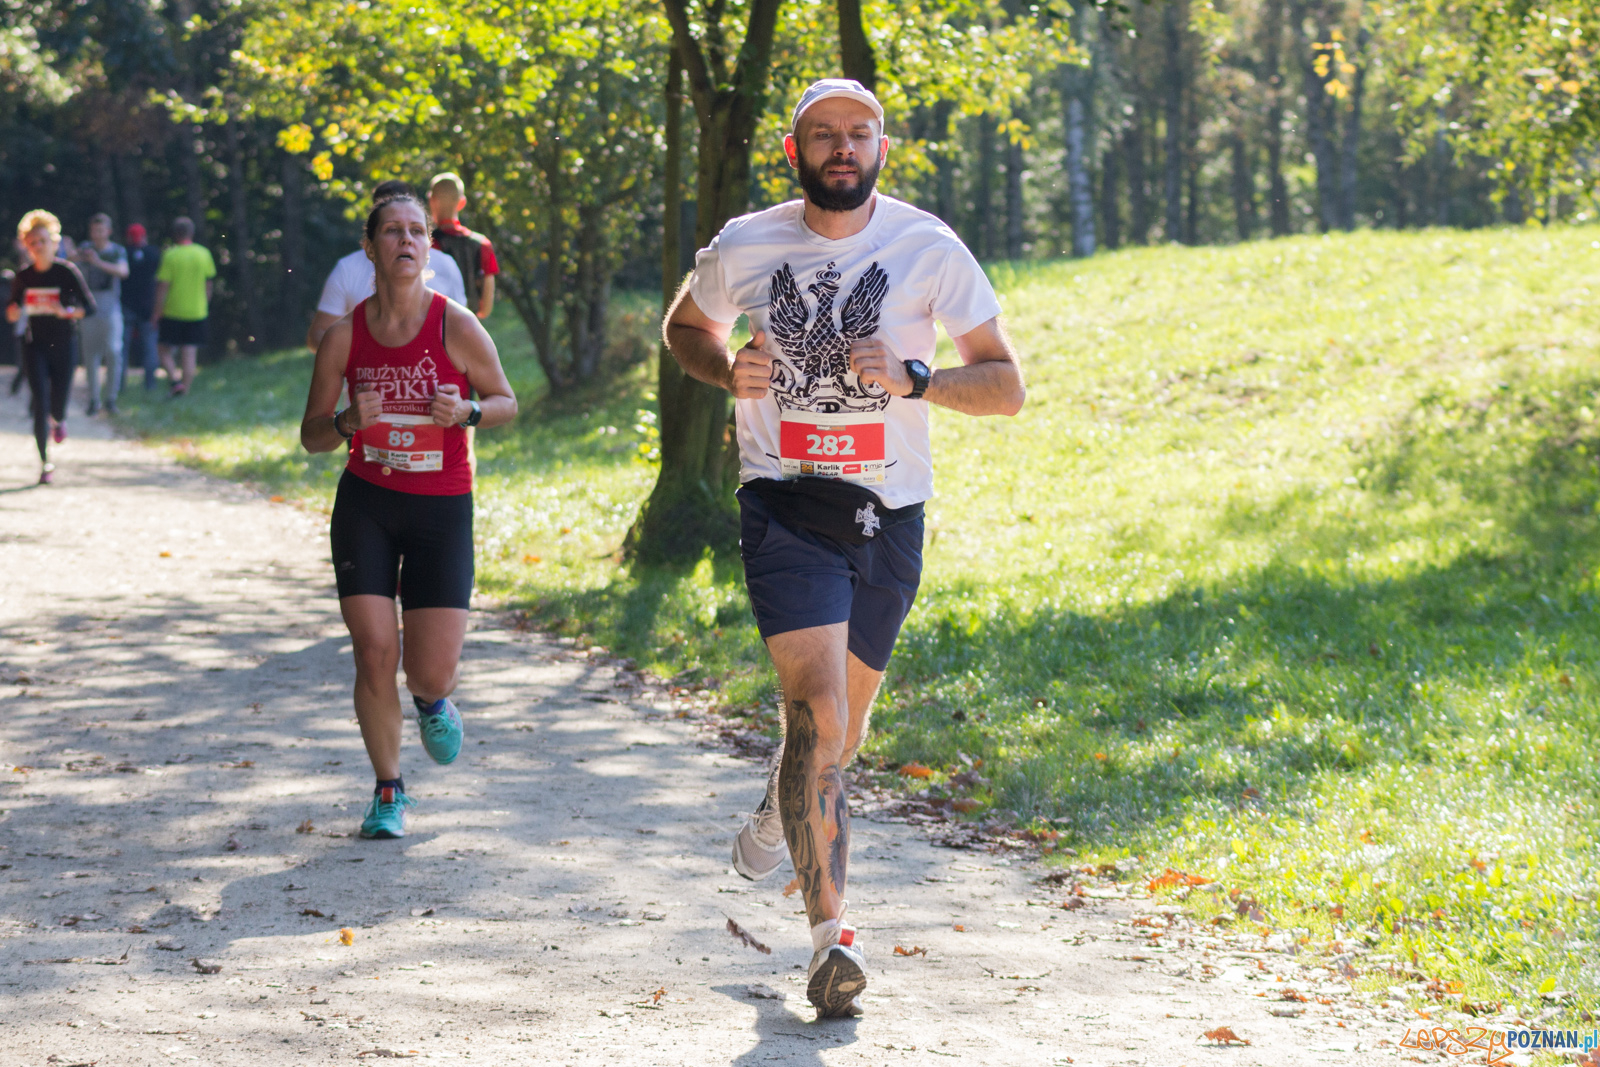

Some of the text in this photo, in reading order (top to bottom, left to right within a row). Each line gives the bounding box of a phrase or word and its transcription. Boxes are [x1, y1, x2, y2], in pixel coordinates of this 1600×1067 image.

[356, 364, 423, 380] DRUŻYNA
[388, 430, 416, 448] 89
[806, 434, 856, 456] 282
